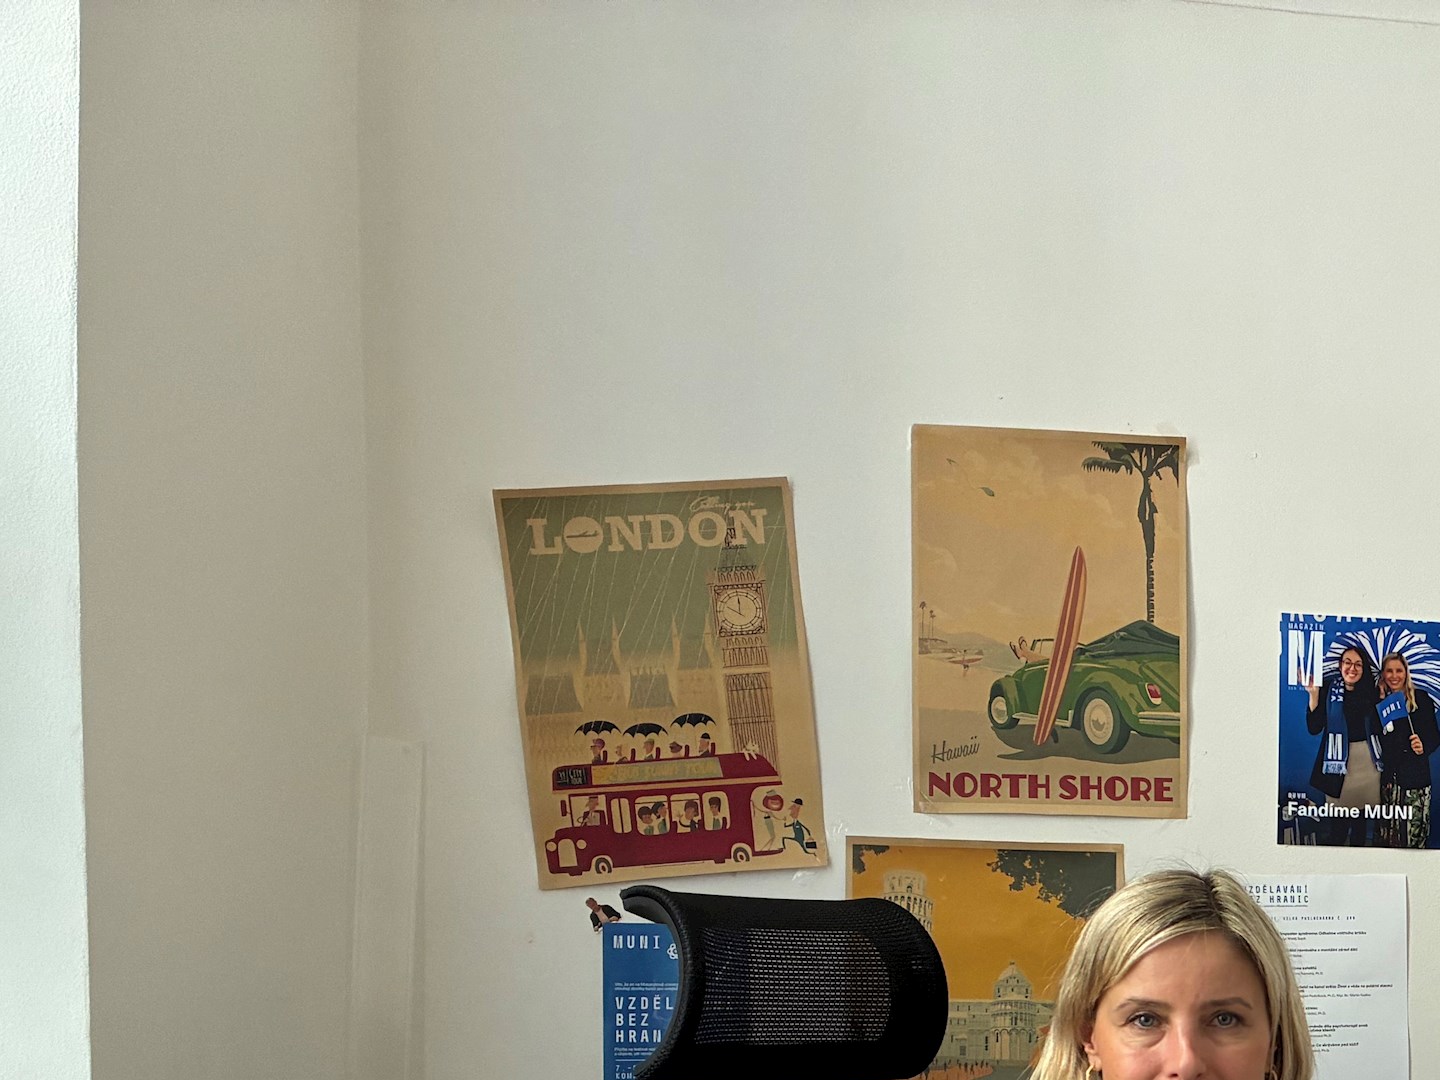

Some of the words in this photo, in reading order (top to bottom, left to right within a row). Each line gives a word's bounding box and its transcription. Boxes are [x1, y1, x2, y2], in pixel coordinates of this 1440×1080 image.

[527, 508, 768, 556] LONDON
[928, 771, 1050, 799] NORTH
[1059, 774, 1174, 802] SHORE
[1288, 801, 1360, 819] Fandíme
[1364, 804, 1413, 820] MUNI
[1245, 884, 1308, 894] ZDĚLÁVÁNÍ
[613, 934, 661, 950] MUNI
[615, 994, 675, 1011] VZDĚL
[615, 1013, 649, 1027] BEZ
[615, 1029, 662, 1043] HRAN
